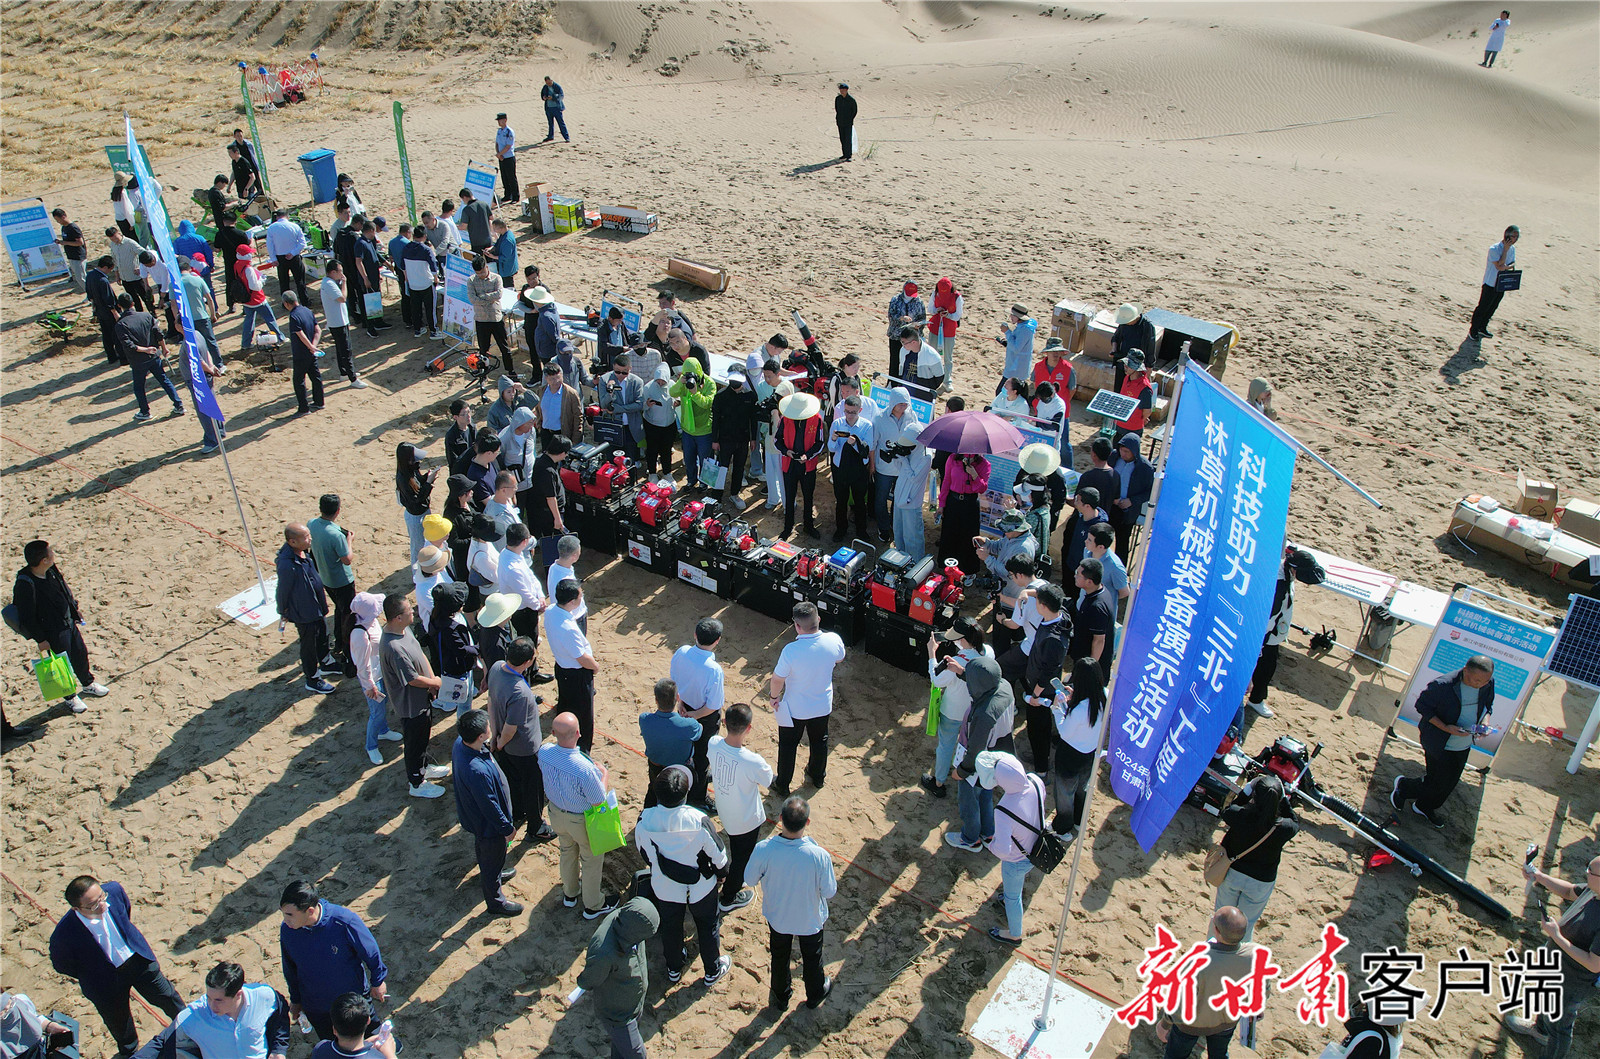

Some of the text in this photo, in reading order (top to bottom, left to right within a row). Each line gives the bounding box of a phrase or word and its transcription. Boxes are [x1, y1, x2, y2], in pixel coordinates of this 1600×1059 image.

[1122, 411, 1229, 750] 林草机械装备演示活动
